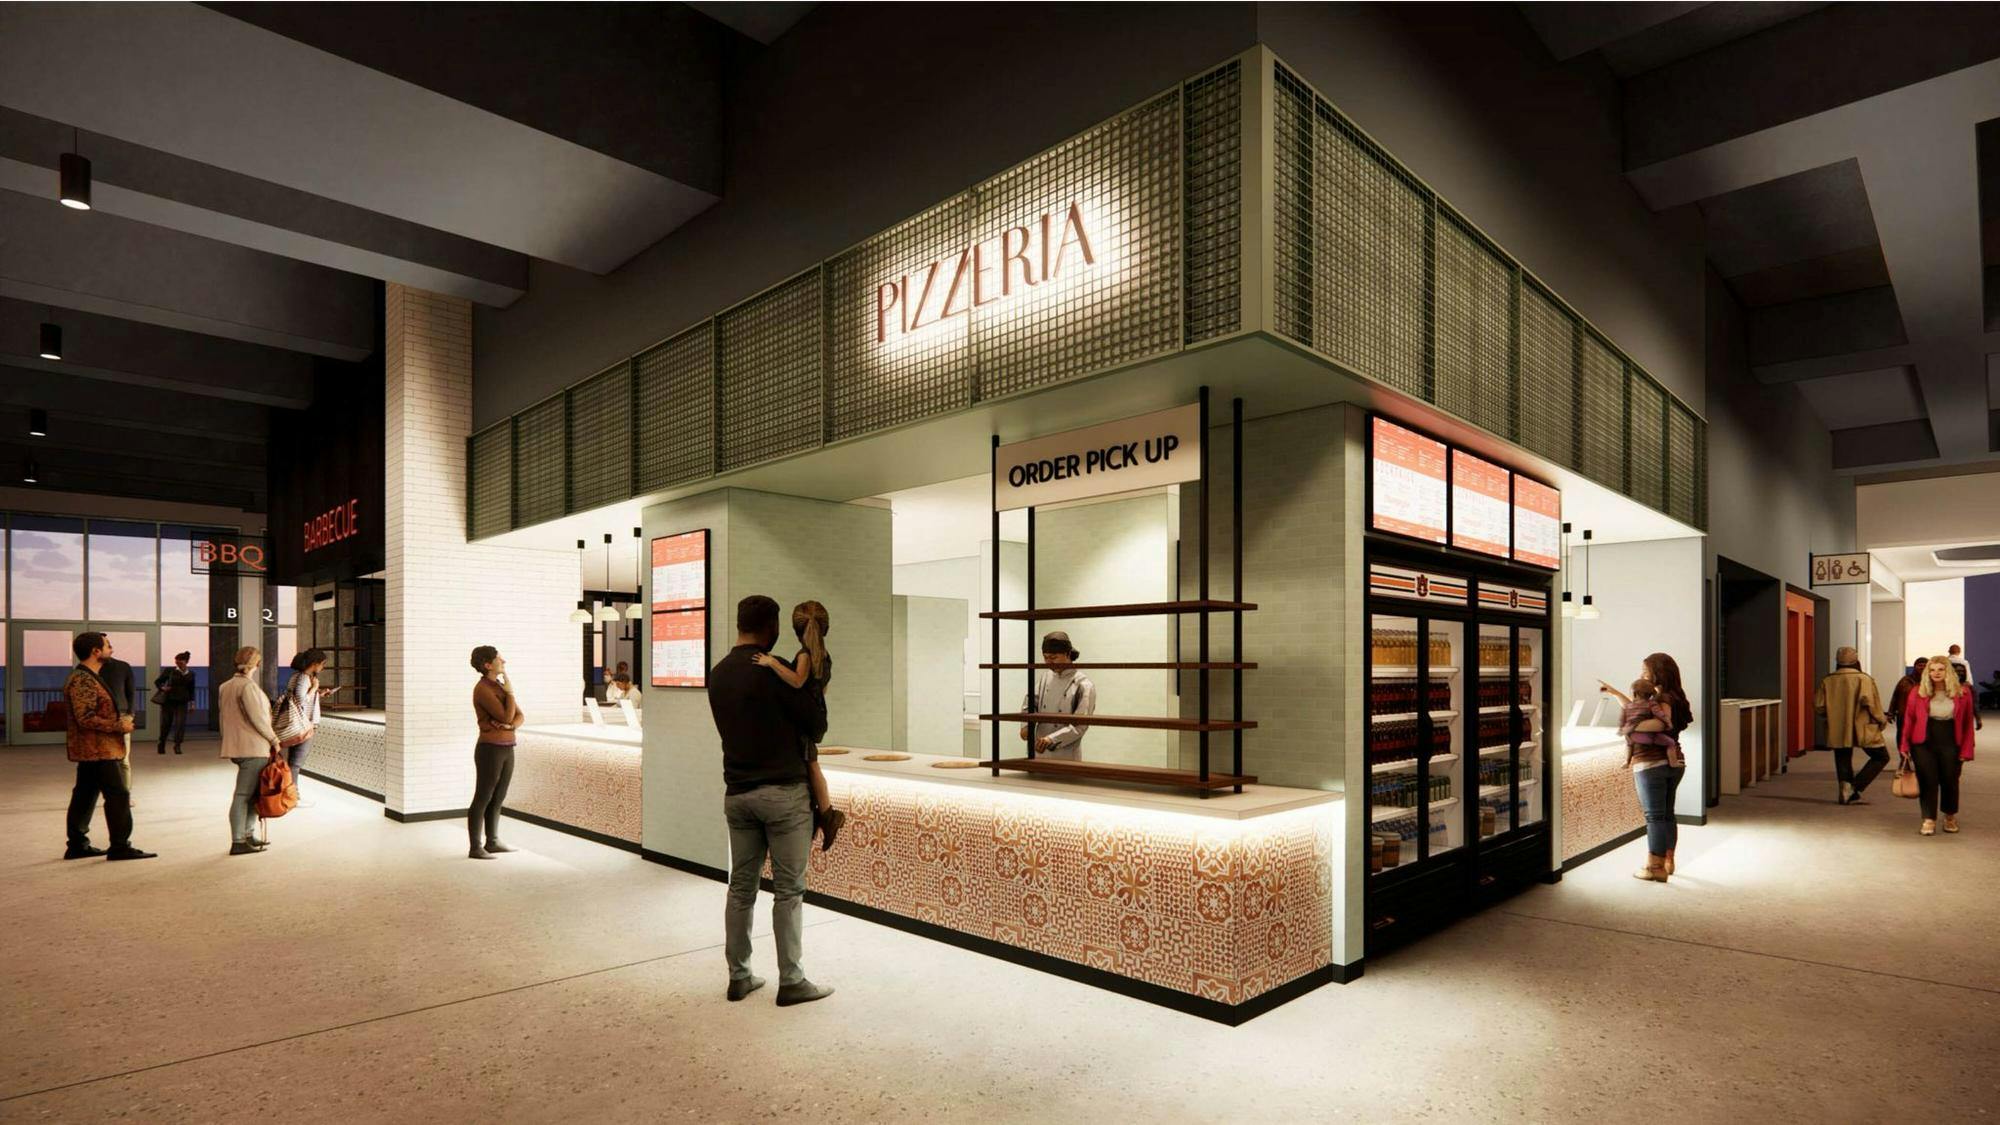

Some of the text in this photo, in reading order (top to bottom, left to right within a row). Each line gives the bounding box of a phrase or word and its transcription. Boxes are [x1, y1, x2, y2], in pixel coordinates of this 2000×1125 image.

[877, 200, 1096, 343] PIZZERIA
[1008, 435, 1179, 488] ORDER PICK UP
[304, 499, 358, 552] BARBECUE
[200, 542, 267, 570] BBQ
